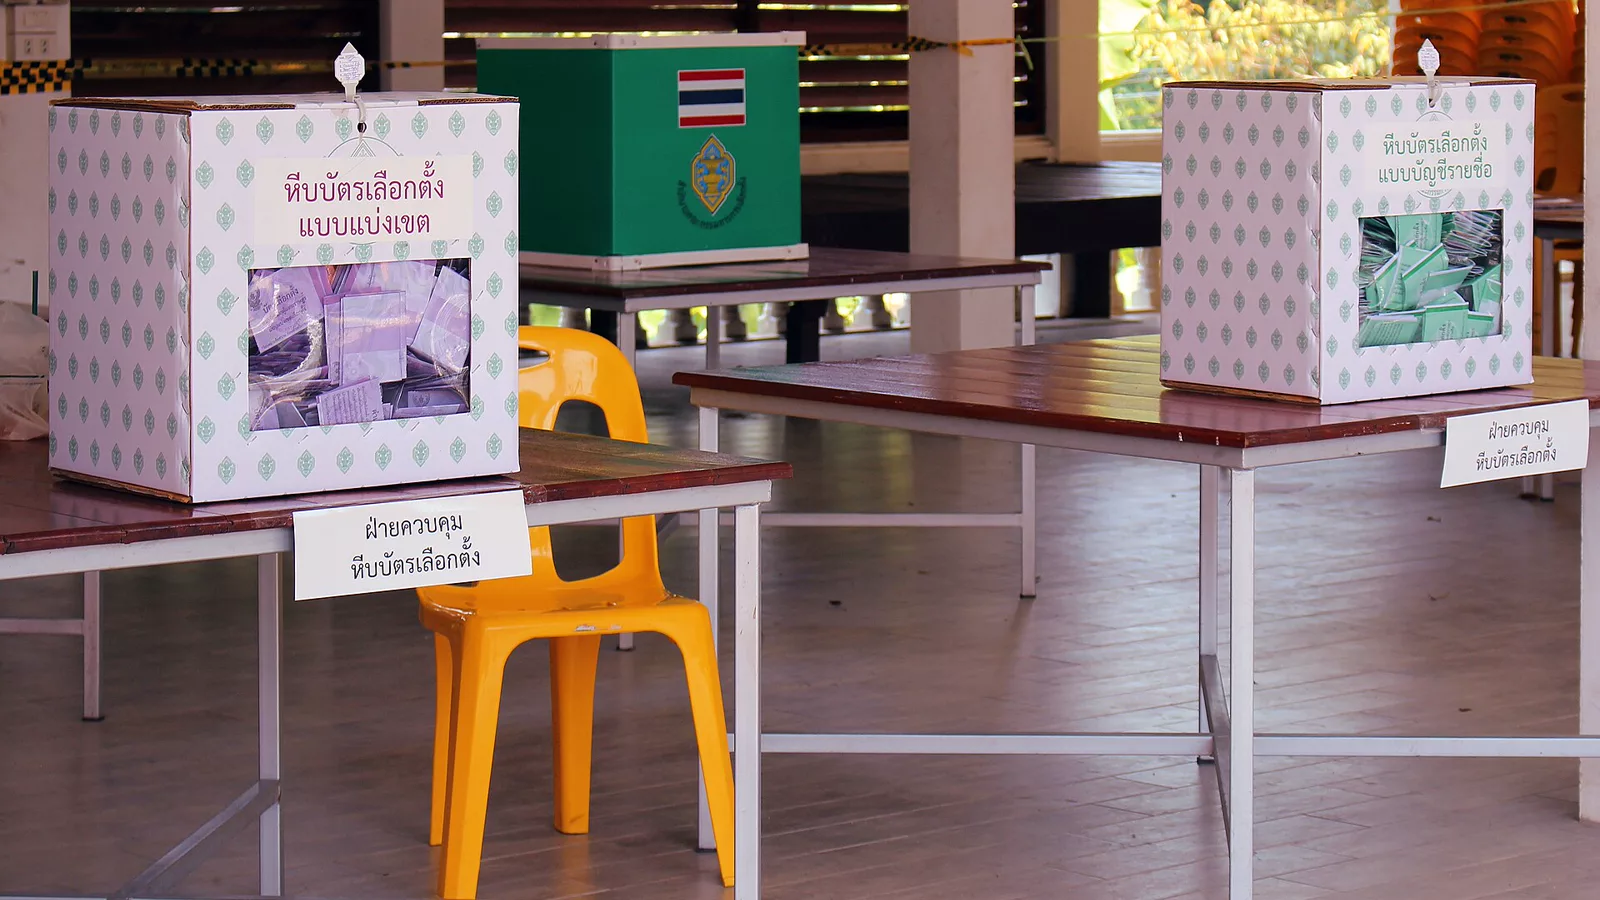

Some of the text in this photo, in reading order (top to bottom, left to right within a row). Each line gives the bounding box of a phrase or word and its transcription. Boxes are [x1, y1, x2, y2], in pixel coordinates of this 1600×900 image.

[1383, 123, 1488, 155] หีบบัตรเลือกตั้ง
[284, 160, 444, 203] หีบบัตรเลือกตั้ง
[1378, 152, 1492, 187] แบบบัญชีรายชื่อ
[299, 207, 430, 237] แบบแบ่งเขต
[1488, 419, 1549, 440] ฝ่ายควบคุม
[1476, 437, 1557, 471] หีบบัตรเลือกตั้ง
[365, 514, 463, 540] ฝ่ายควบคุม
[351, 536, 481, 579] หีบบัตรเลือกตั้ง
